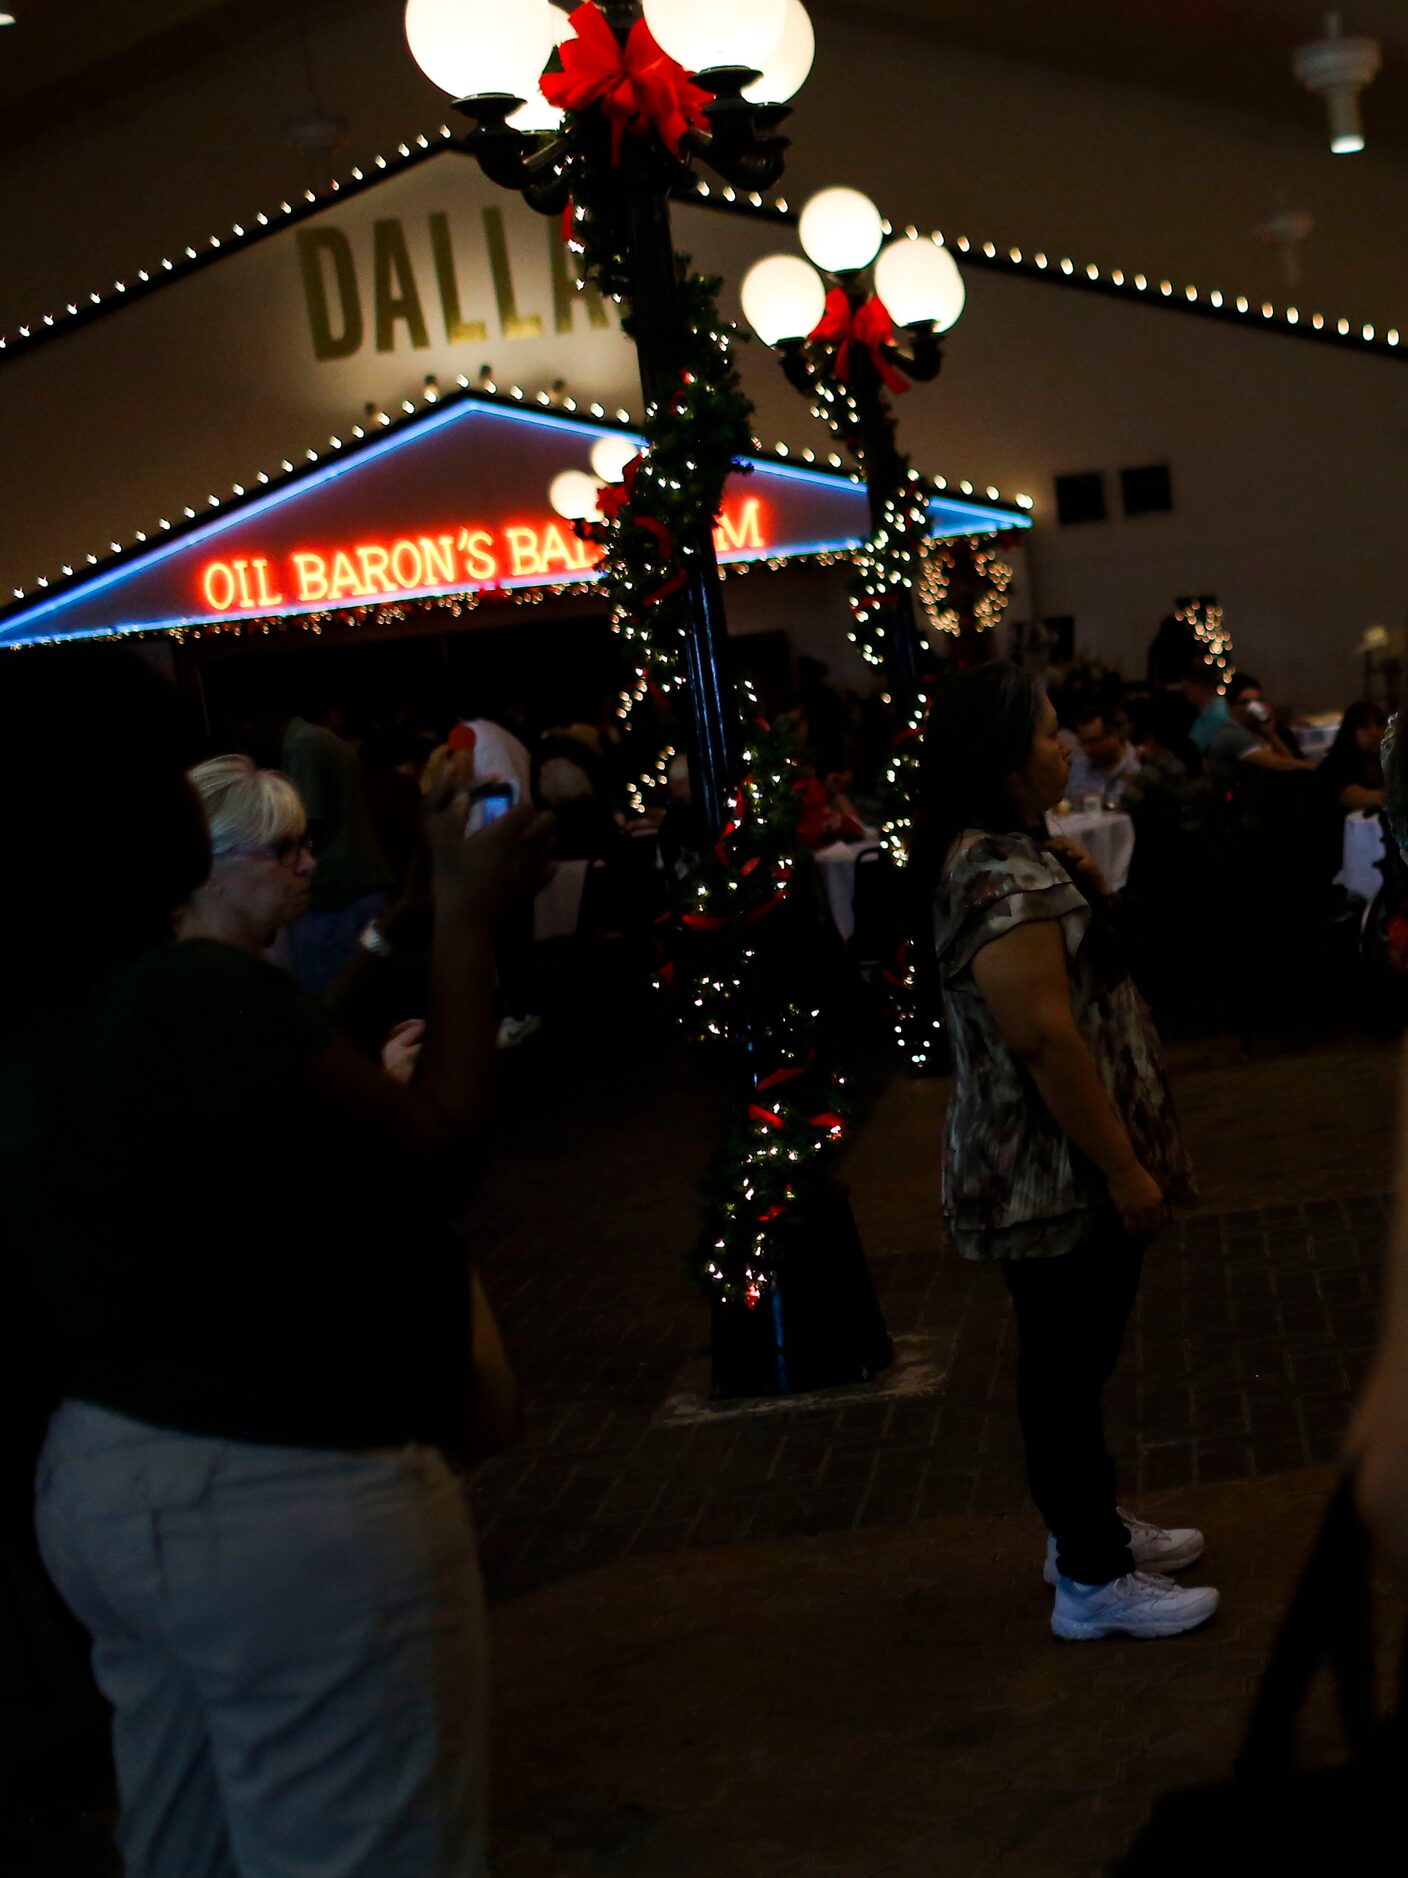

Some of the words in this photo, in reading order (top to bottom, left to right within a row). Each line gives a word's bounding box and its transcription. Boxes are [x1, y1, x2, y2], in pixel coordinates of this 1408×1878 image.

[296, 206, 633, 362] DALLA
[203, 558, 283, 611] OIL
[292, 526, 496, 602] BARON'S
